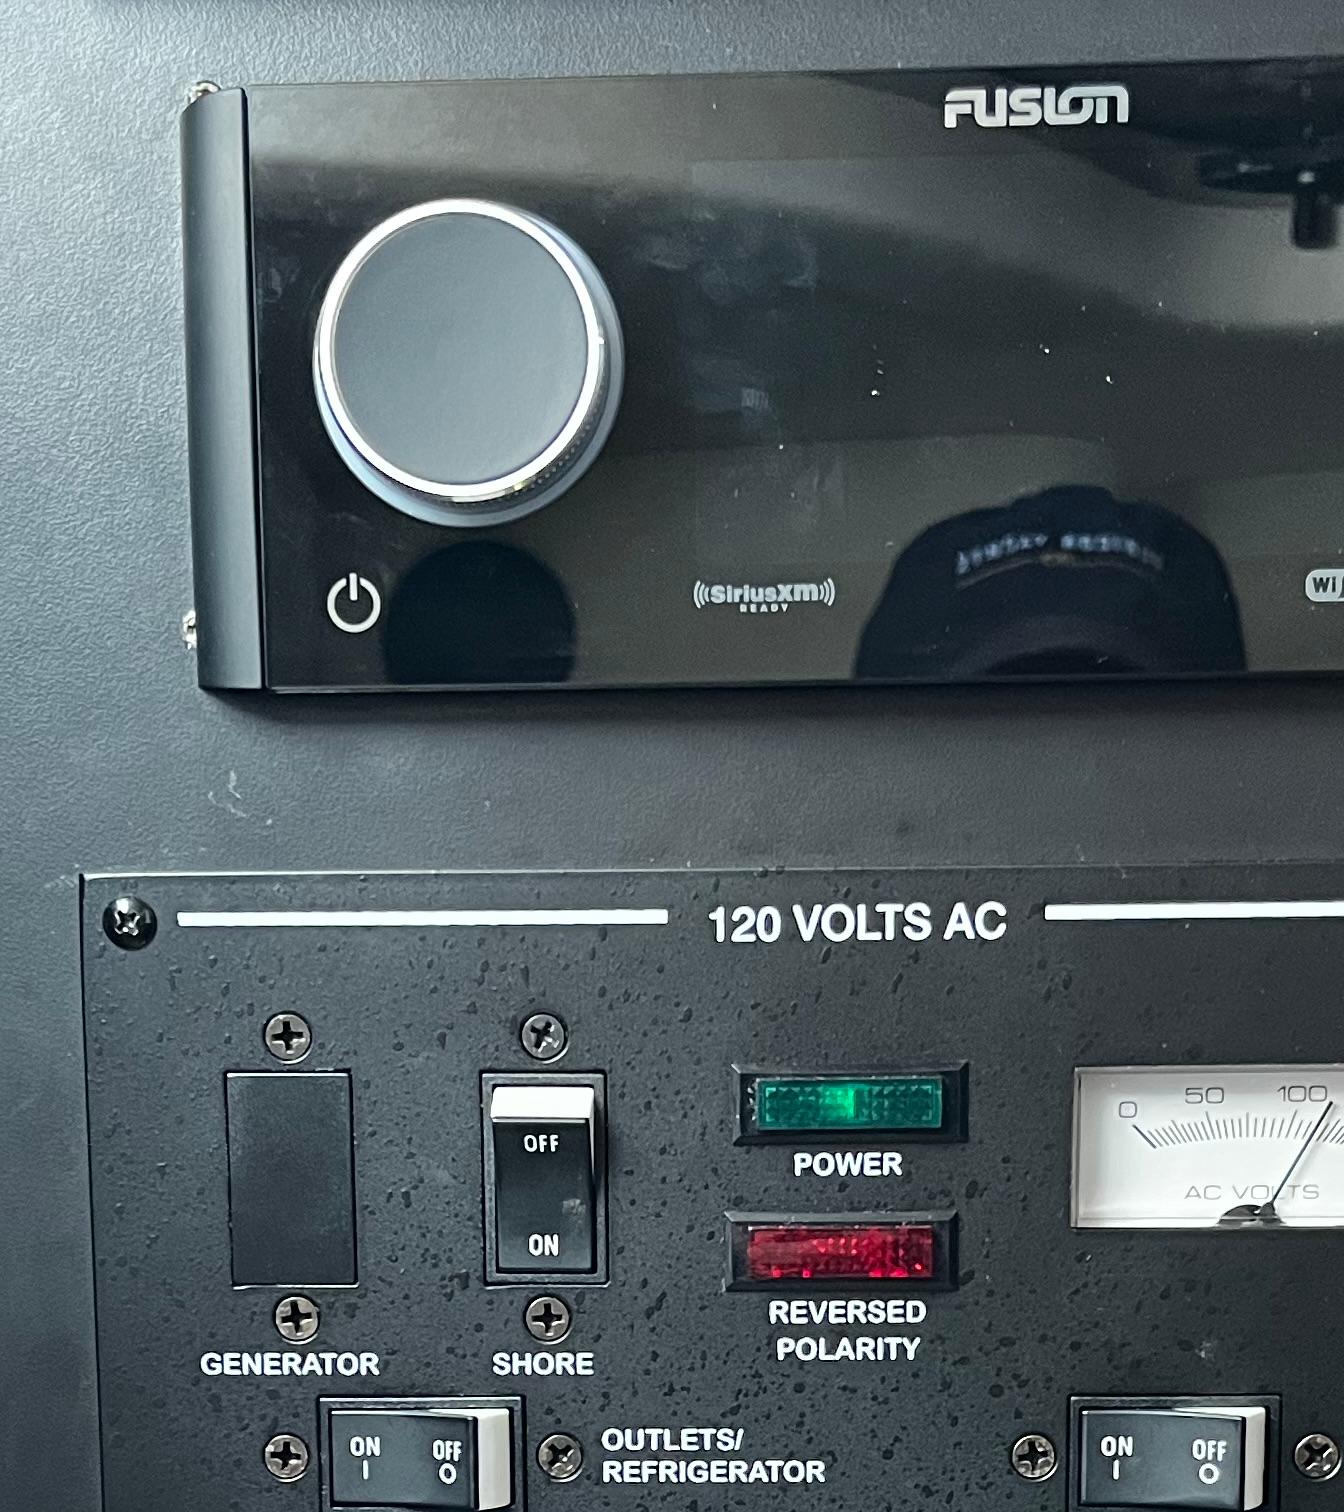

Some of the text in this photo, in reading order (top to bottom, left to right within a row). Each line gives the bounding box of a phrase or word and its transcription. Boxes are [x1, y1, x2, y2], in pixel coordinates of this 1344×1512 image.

[944, 85, 1129, 129] FUSION
[739, 603, 789, 613] READY
[708, 900, 1007, 943] 120 VOLTS AC
[1184, 1086, 1225, 1104] 50
[1276, 1084, 1328, 1103] 100
[1118, 1100, 1138, 1119] 0
[523, 1134, 559, 1153] OFF
[793, 1151, 903, 1177] POWER
[1183, 1184, 1320, 1200] AC VOLTS
[528, 1233, 559, 1257] ON
[768, 1299, 927, 1325] REVERSED
[776, 1336, 921, 1361] POLARITY
[200, 1352, 380, 1377] GENERATOR
[492, 1351, 595, 1376] SHORE
[349, 1436, 381, 1462] ON
[432, 1439, 462, 1462] OFF
[601, 1427, 745, 1452] OUTLETS/
[1100, 1435, 1134, 1462] ON
[1192, 1438, 1227, 1462] OFF
[602, 1459, 826, 1484] REFRIGERATOR
